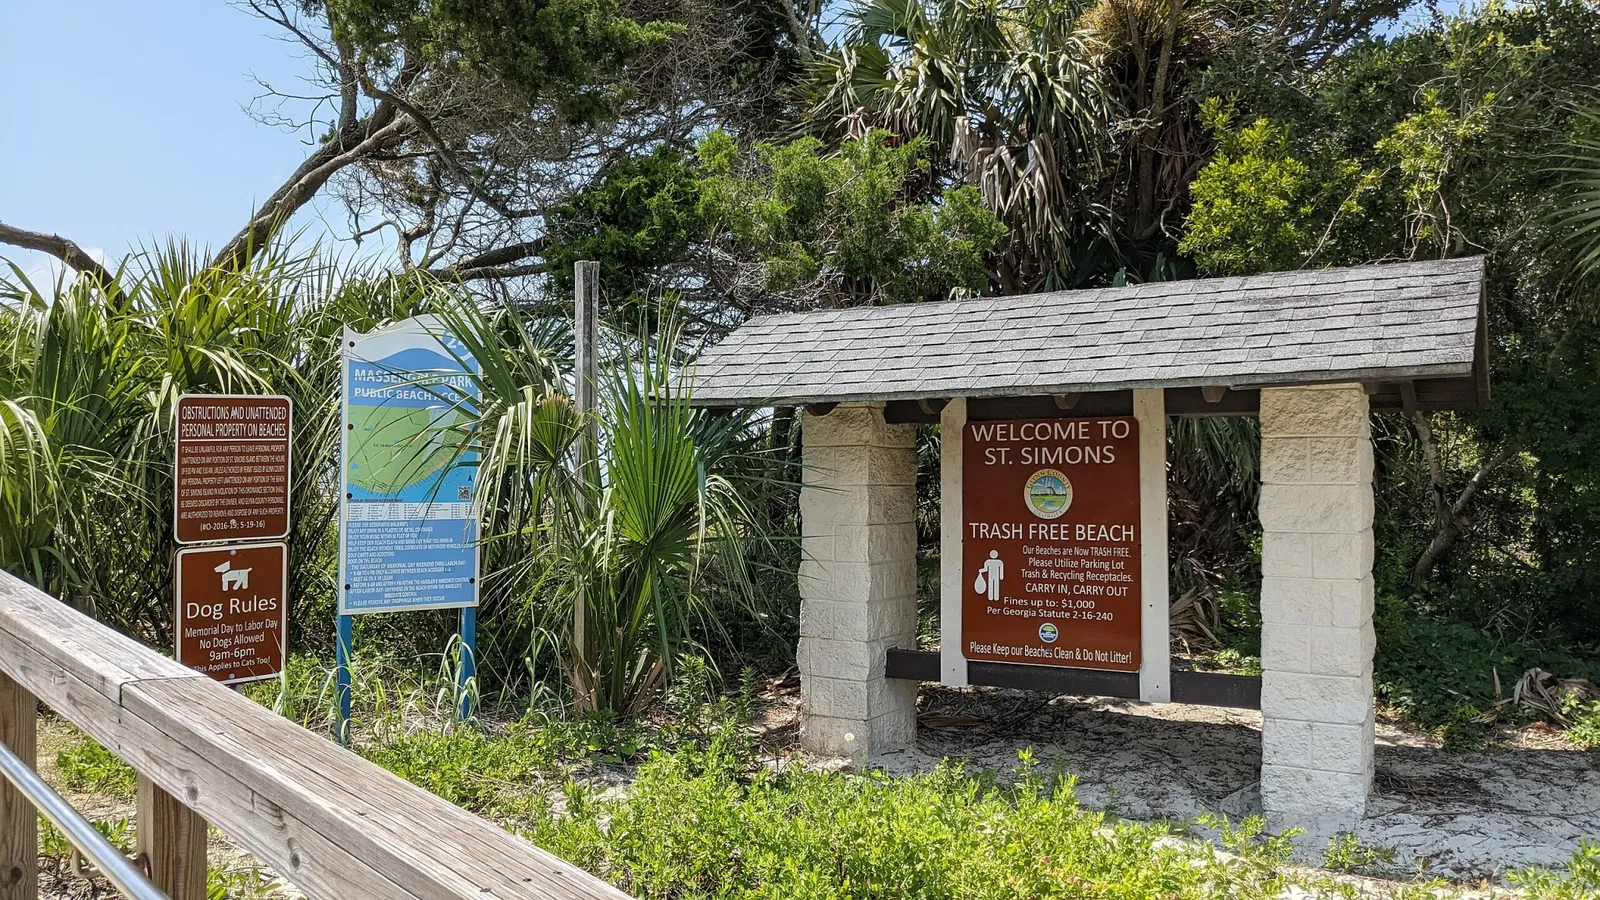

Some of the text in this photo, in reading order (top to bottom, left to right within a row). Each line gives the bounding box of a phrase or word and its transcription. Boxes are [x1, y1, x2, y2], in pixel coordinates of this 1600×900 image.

[441, 376, 473, 389] PARK
[355, 388, 395, 399] PUBLIC
[396, 389, 432, 401] BEACH
[182, 406, 287, 420] OBSTRUCTIONS AND UNATTENDED
[181, 423, 286, 437] PERSONAL PROPERTY ON BEACHES
[971, 420, 1130, 442] WELCOME TO
[984, 445, 1116, 466] ST. SIMONS
[240, 520, 266, 530] 5-19-16)
[969, 522, 1135, 543] TRASH FREE BEACH
[1022, 545, 1132, 558] Our Beaches are Now TRASH FREE.
[1028, 557, 1125, 572] Please Utilize Parking Lot
[1020, 568, 1134, 583] Trash & Recycling Receptacles.
[1025, 582, 1129, 598] CARRY IN, CARRY OUT
[186, 594, 278, 620] Dog Rules
[1003, 596, 1096, 611] Fines up to: $1,000
[987, 606, 1114, 622] Per Georgia Statute 2-16-240
[184, 618, 279, 639] Memorial Day to Labor Day
[199, 631, 265, 650] No Dogs Allowed
[209, 647, 256, 662] 9am-6pm
[970, 641, 1132, 665] Please Keep our Beaches Clean & Do Not Litter!
[208, 660, 232, 673] Applies
[233, 659, 241, 669] to
[241, 657, 256, 668] Cats
[256, 655, 271, 667] Too!
